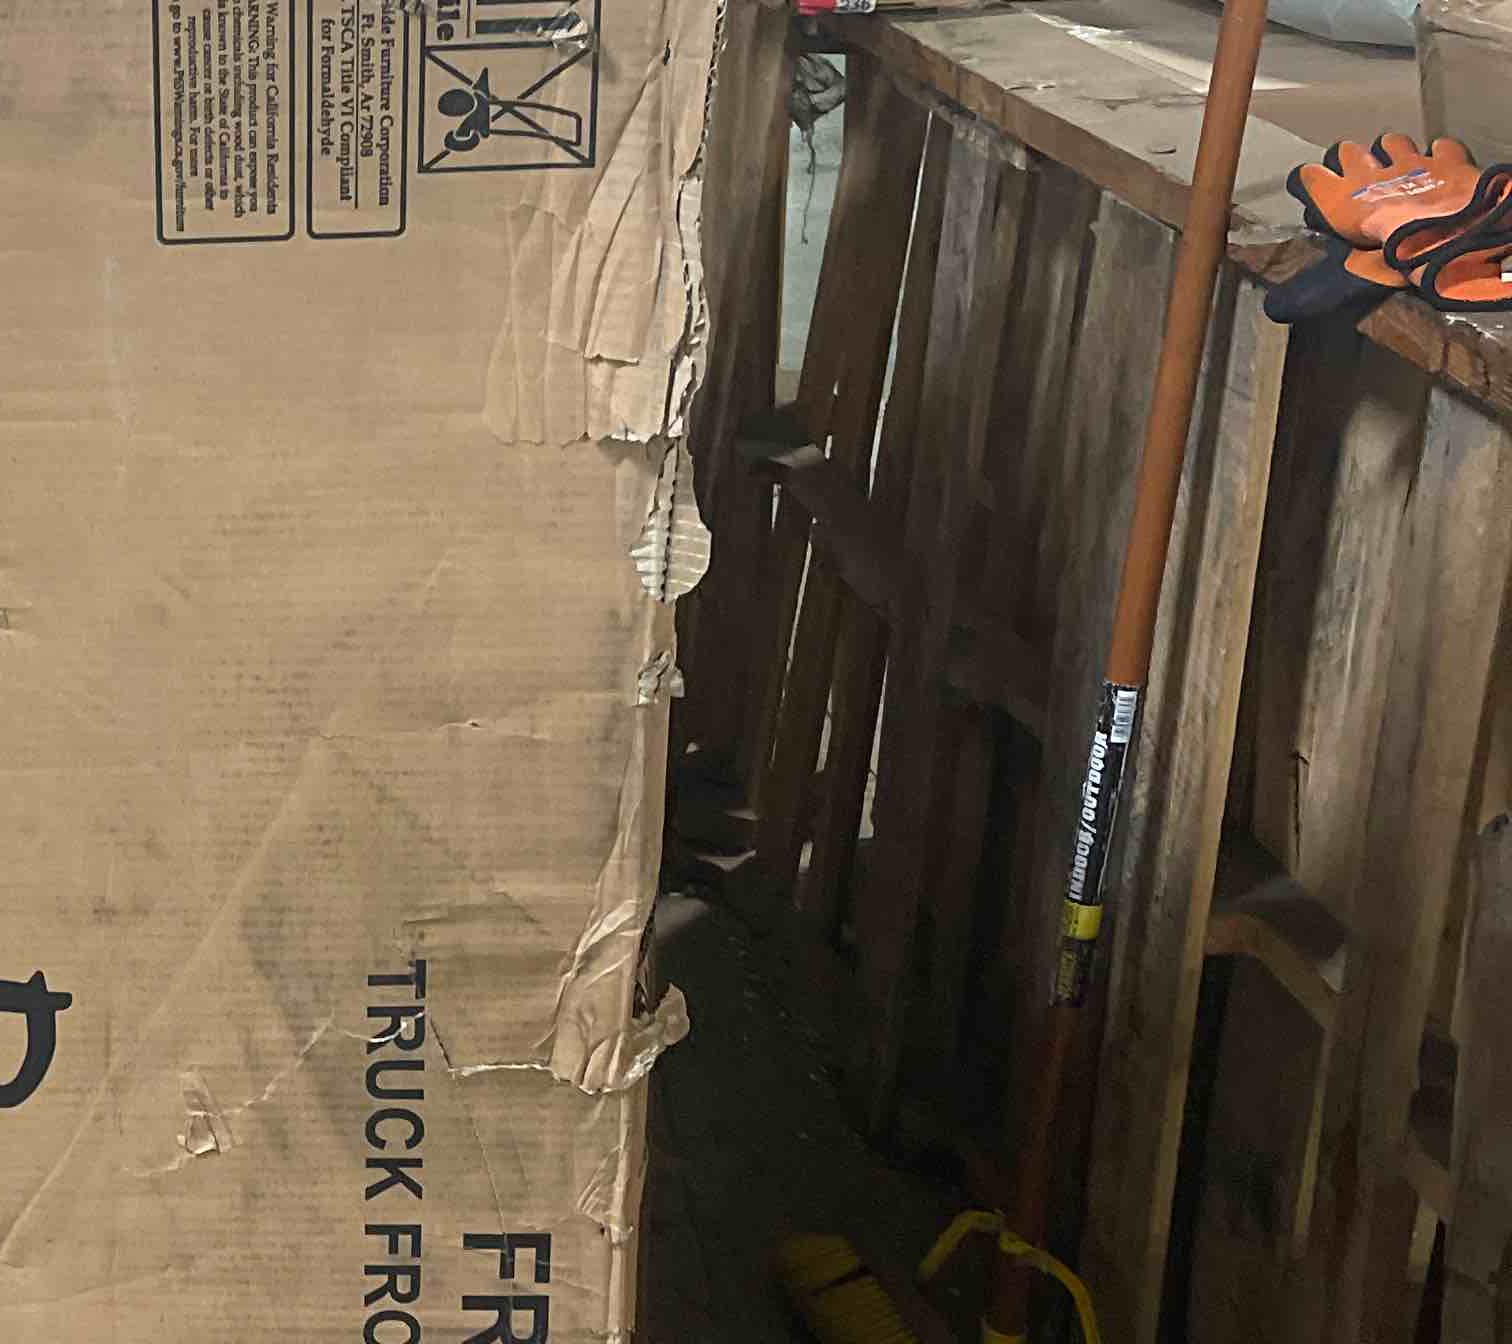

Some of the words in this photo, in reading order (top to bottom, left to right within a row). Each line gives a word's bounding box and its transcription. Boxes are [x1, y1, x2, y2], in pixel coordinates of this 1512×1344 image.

[263, 2, 278, 60] Warning
[321, 18, 336, 42] for
[341, 8, 354, 52] TSCA
[248, 57, 260, 81] This
[266, 63, 279, 82] for
[340, 58, 354, 94] Title
[357, 37, 373, 87] Smith,
[379, 38, 394, 111] Furniture
[245, 83, 259, 127] product
[266, 85, 278, 150] California
[316, 45, 336, 155] Formaldehyde
[341, 98, 353, 117] VI
[360, 92, 373, 113] Ar
[266, 153, 278, 215] Residents
[336, 119, 353, 201] Compliant
[376, 116, 392, 207] Corporation
[1068, 730, 1109, 902] INDOOR/OUTDOOR
[361, 958, 427, 1202] TRUCK
